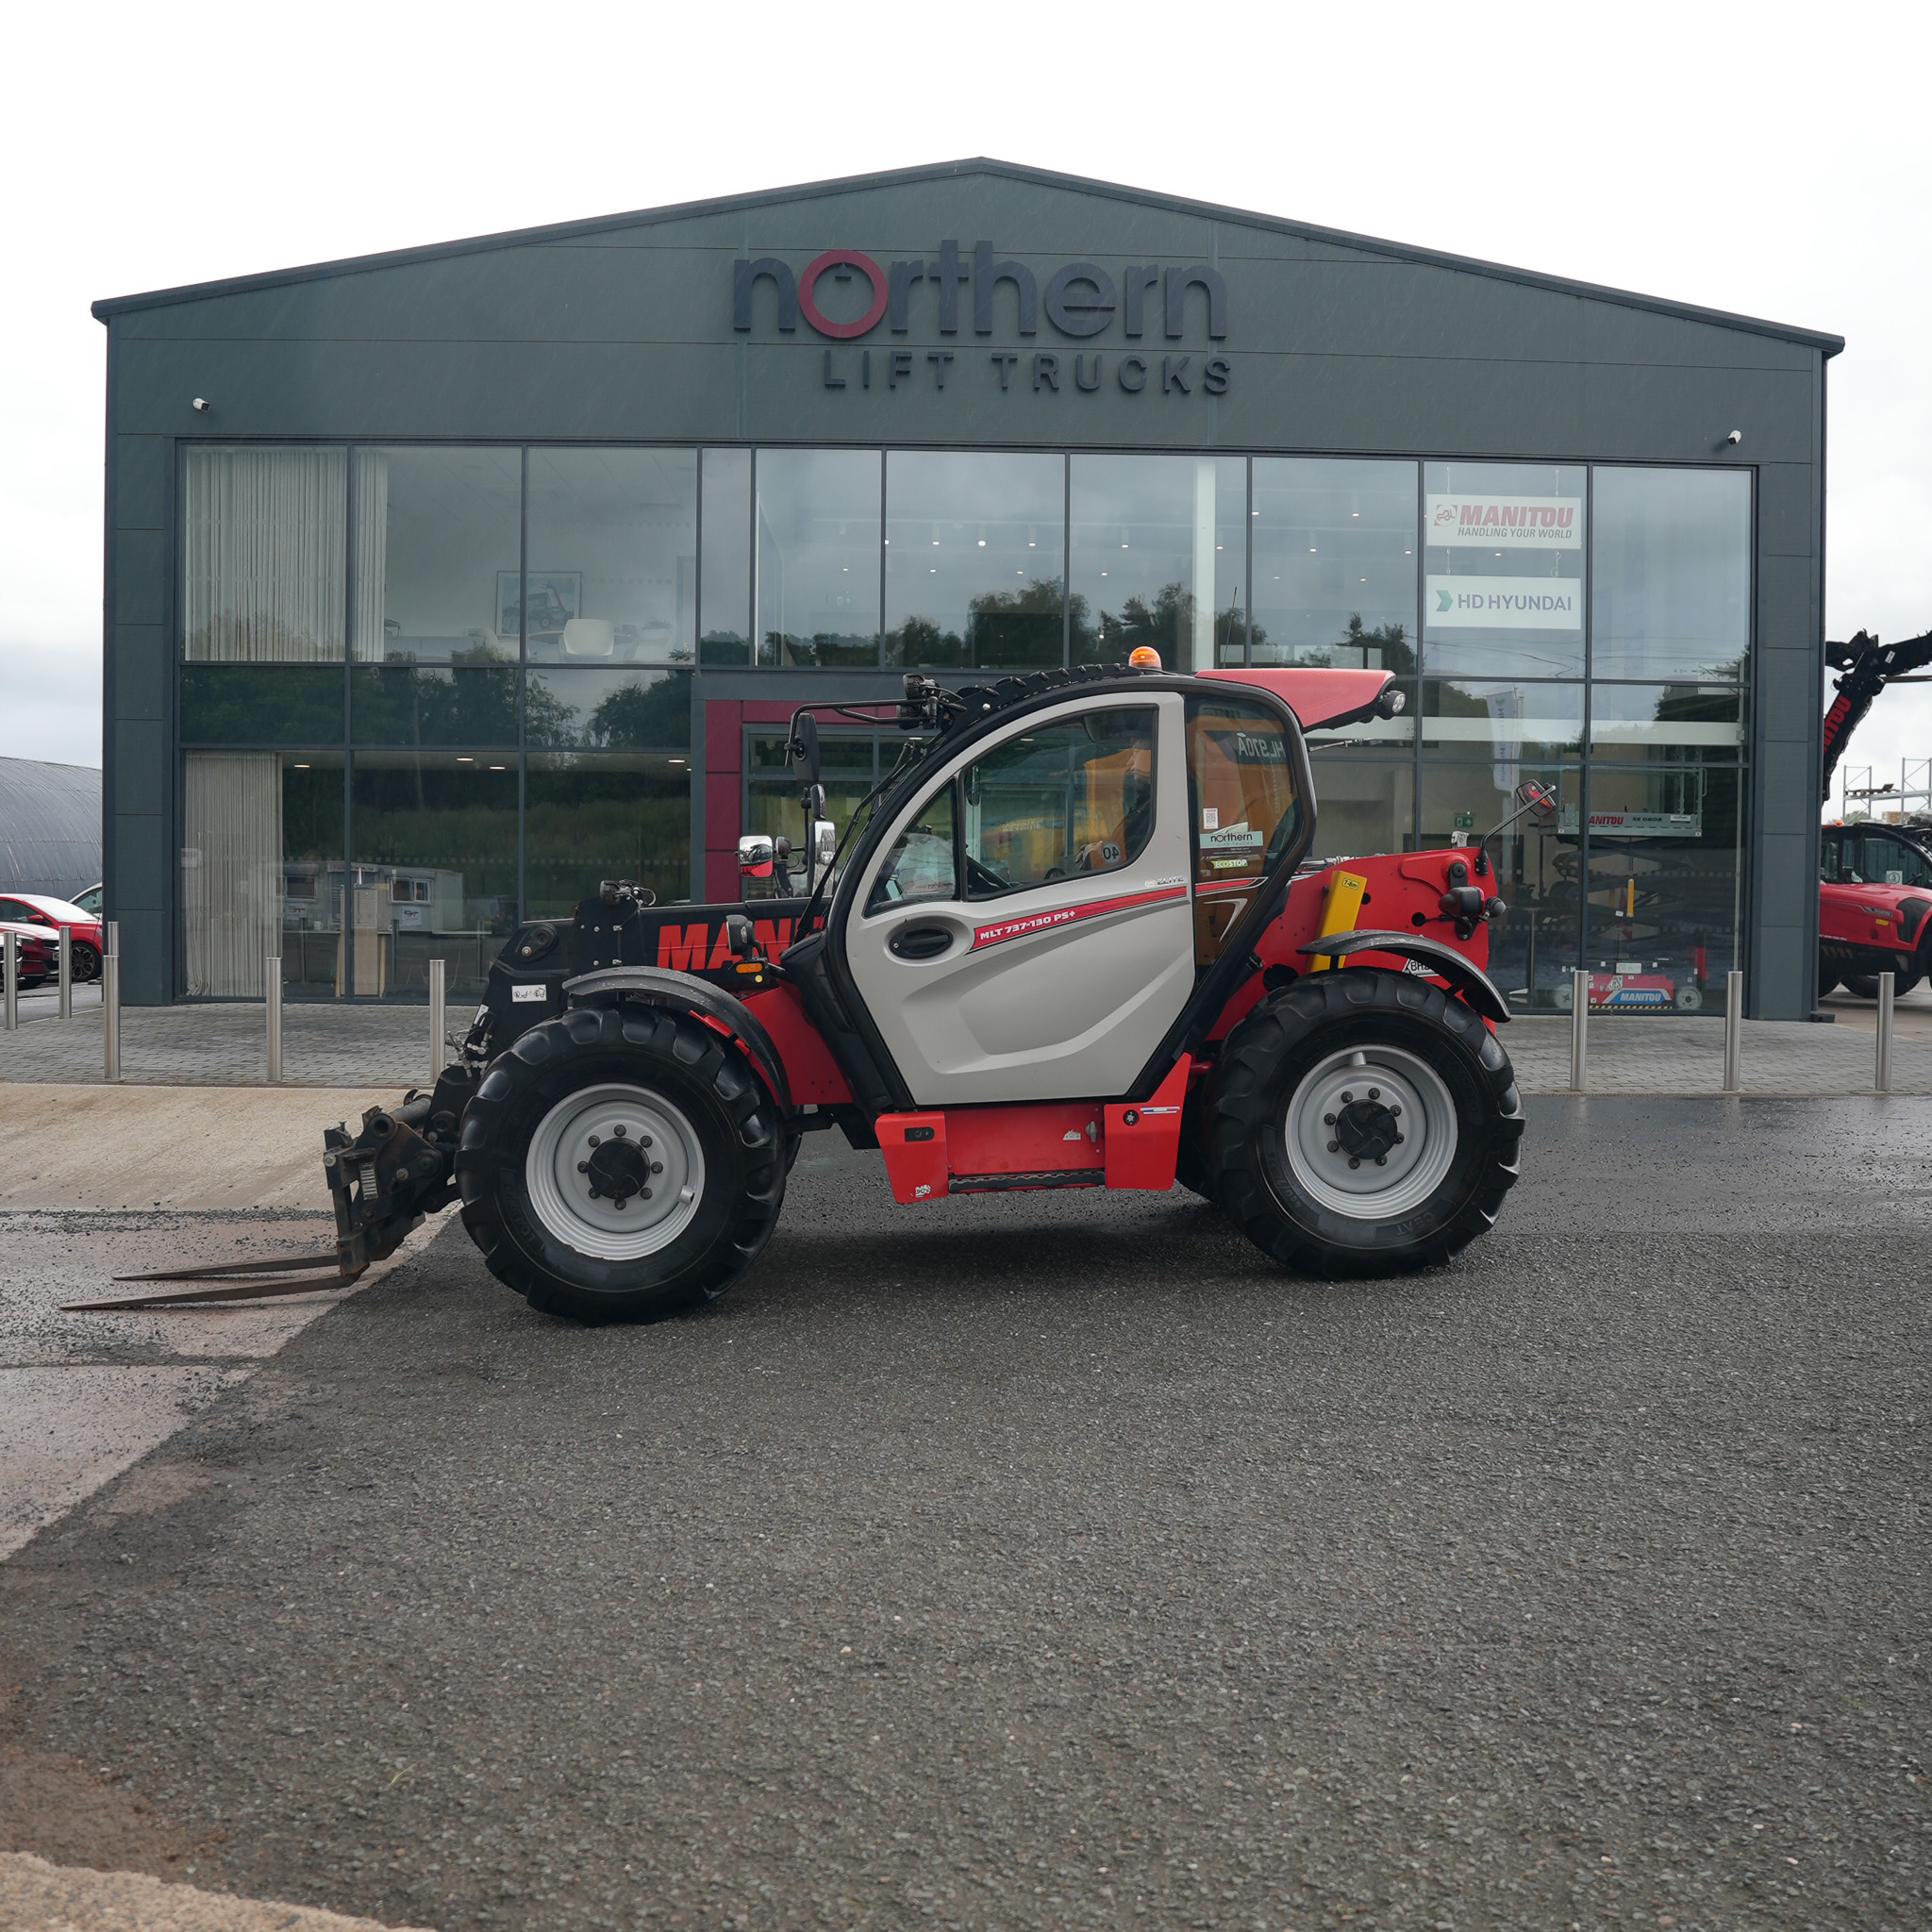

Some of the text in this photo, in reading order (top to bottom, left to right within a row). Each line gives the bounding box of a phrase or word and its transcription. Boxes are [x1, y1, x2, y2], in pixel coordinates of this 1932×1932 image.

[733, 239, 1226, 339] northern
[824, 349, 1232, 394] LIFT TRUCKS
[1459, 505, 1574, 528] MANITOU
[1457, 526, 1573, 539] HANDLING YOUR WORLD
[1457, 593, 1572, 611] HD HYUNDAI
[1210, 833, 1253, 842] northern
[1215, 858, 1247, 868] ECOSTOP
[980, 910, 1075, 940] MLT 737-130 PS+
[1620, 992, 1661, 1002] MANITOU
